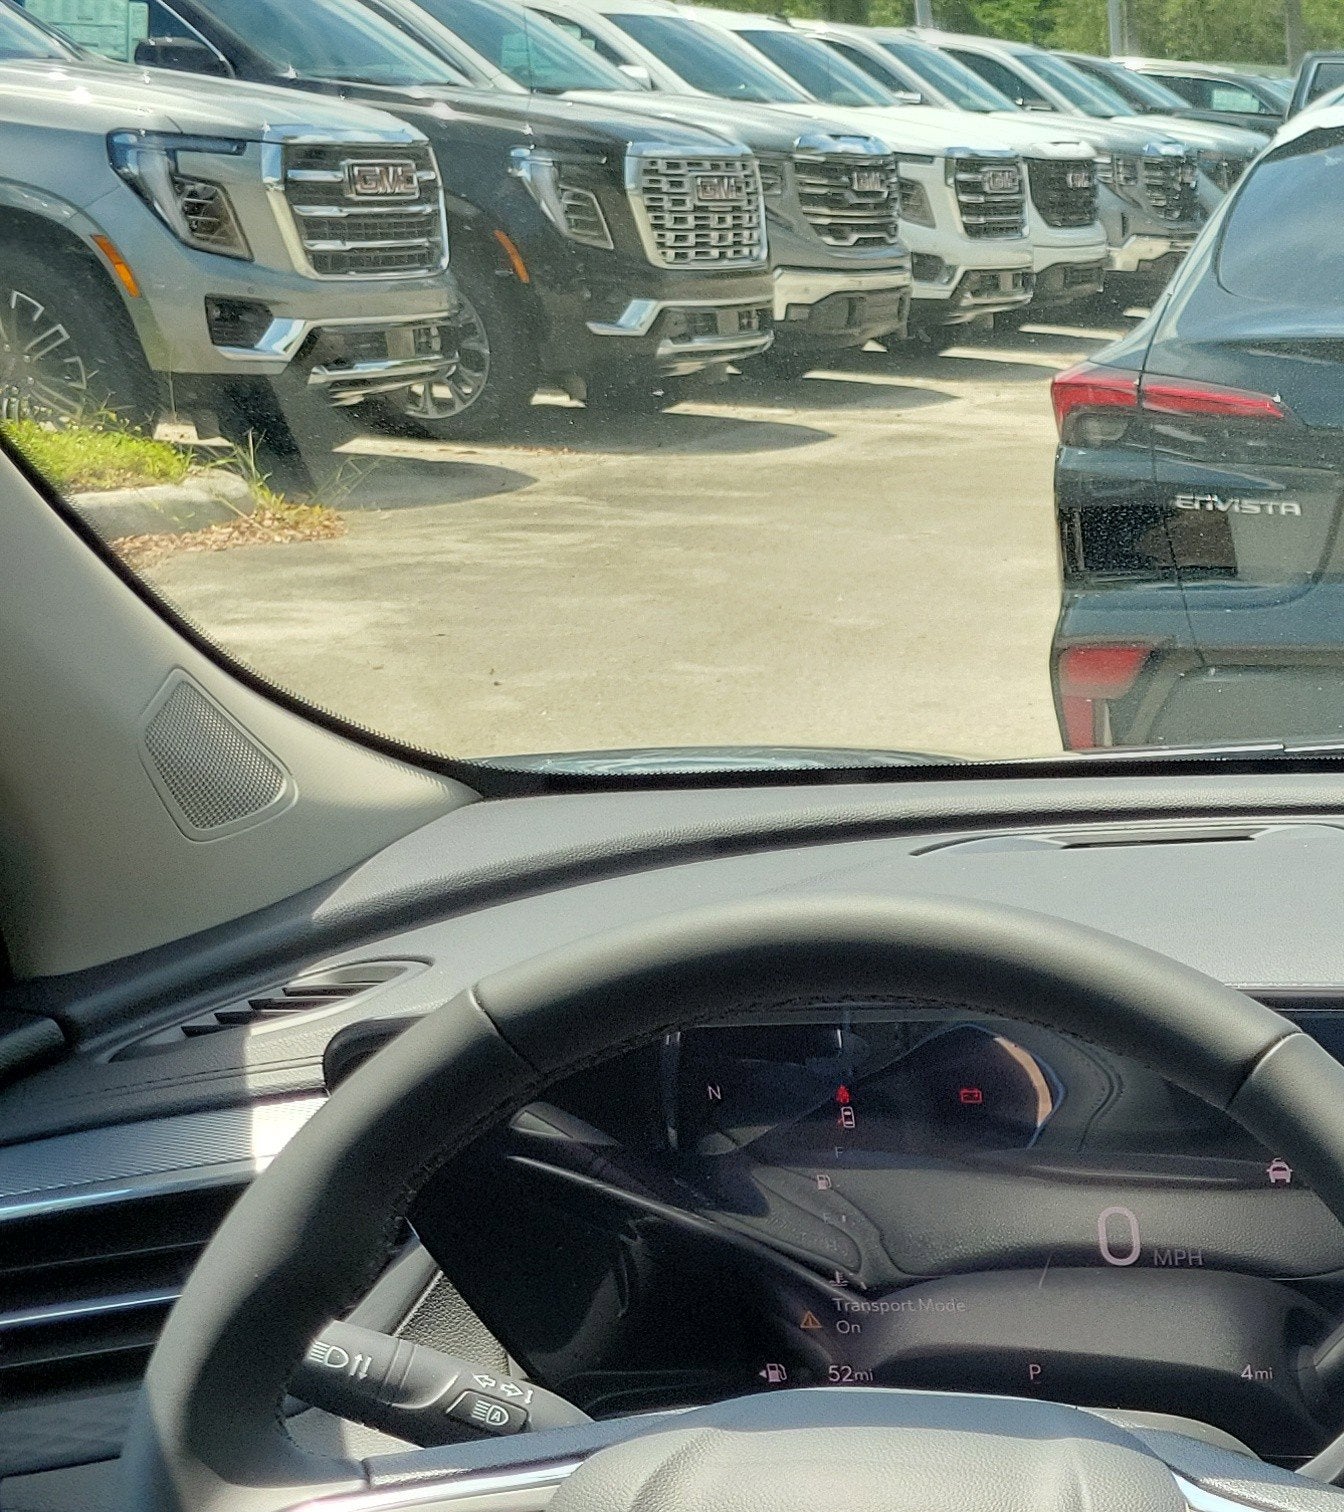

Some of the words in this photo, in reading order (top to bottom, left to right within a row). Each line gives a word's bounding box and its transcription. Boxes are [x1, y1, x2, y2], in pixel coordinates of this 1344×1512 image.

[356, 167, 418, 196] GMC
[1175, 494, 1301, 516] ENVISTA
[707, 1084, 721, 1100] N
[1153, 1250, 1203, 1266] MPH
[832, 1298, 914, 1314] Transport
[918, 1298, 967, 1312] Mode
[836, 1320, 861, 1334] On
[1029, 1363, 1041, 1380] P
